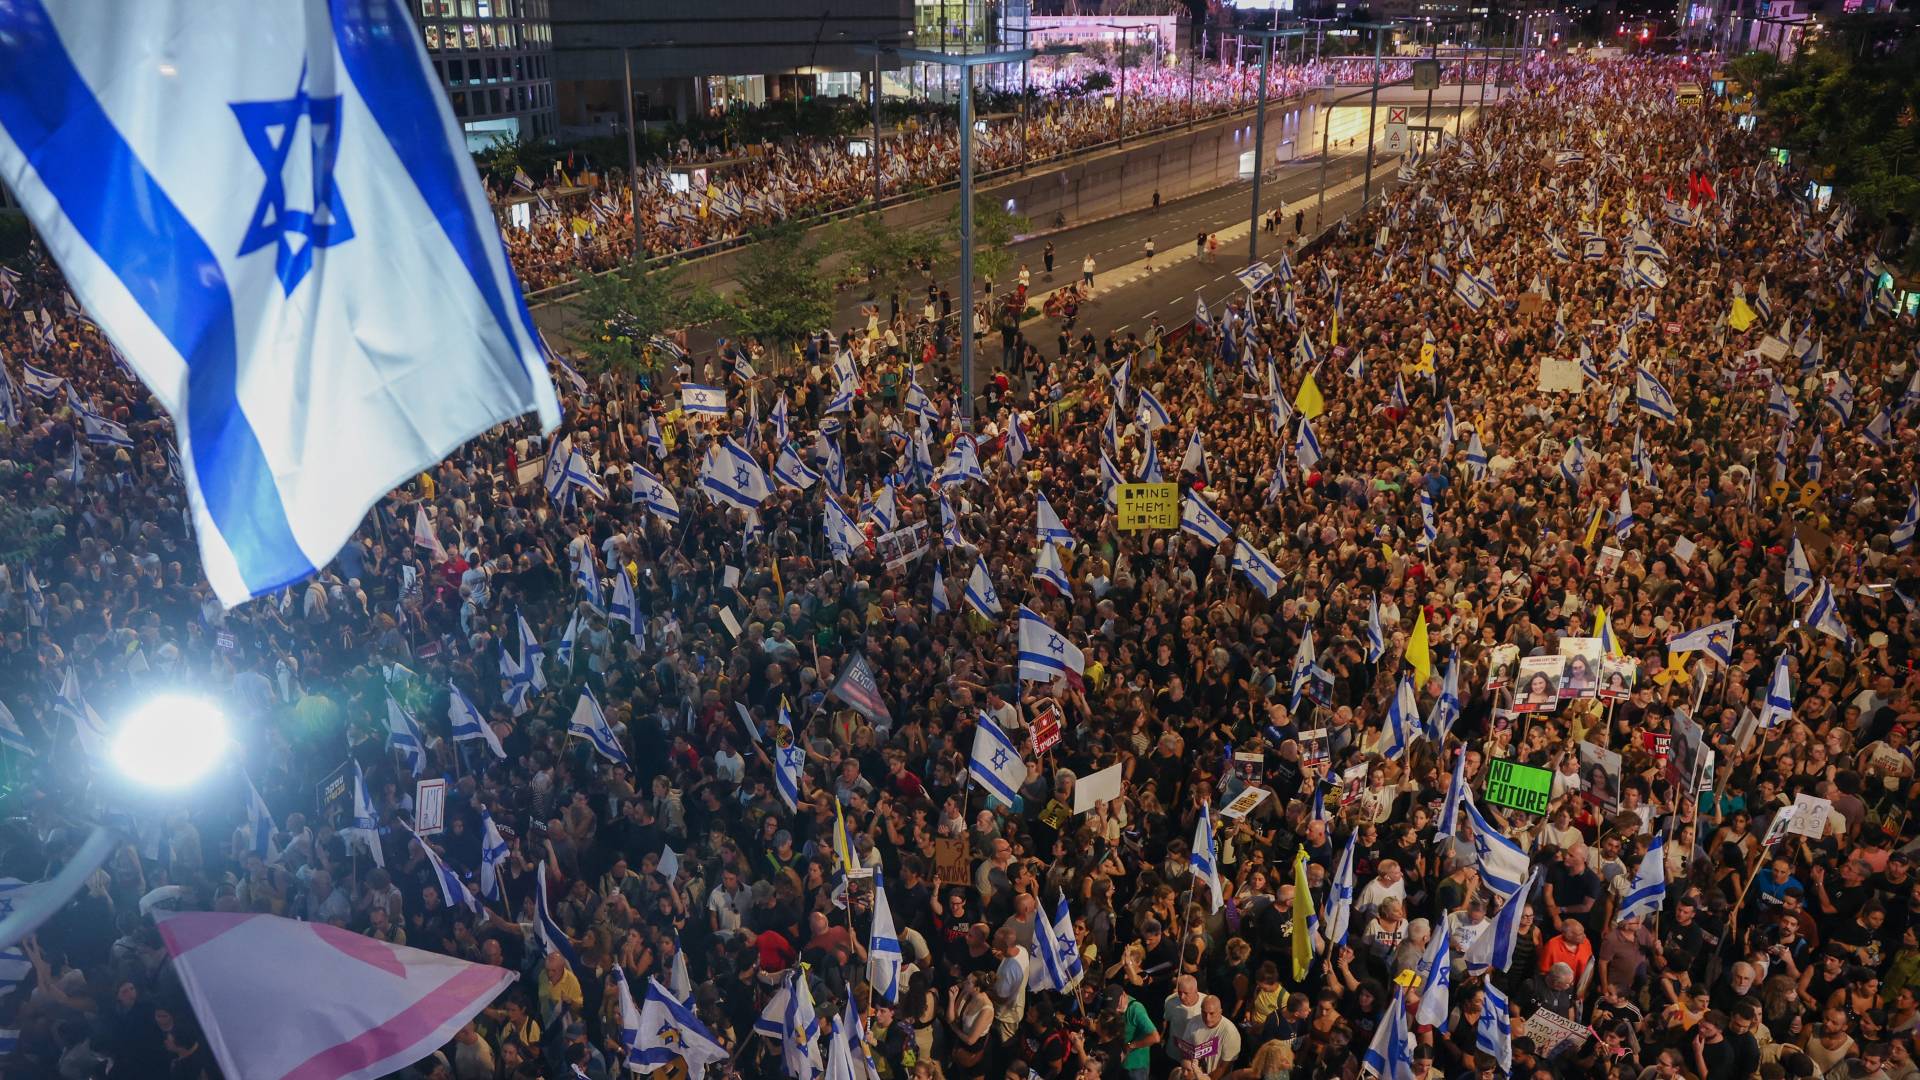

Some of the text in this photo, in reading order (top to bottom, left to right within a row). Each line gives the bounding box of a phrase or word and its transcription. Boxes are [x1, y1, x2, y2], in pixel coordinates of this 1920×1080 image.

[1125, 488, 1169, 499] BRING
[1125, 502, 1164, 512] THEM
[1127, 514, 1171, 526] HOME!
[1491, 760, 1514, 783] NO
[1487, 781, 1548, 813] FUTURE
